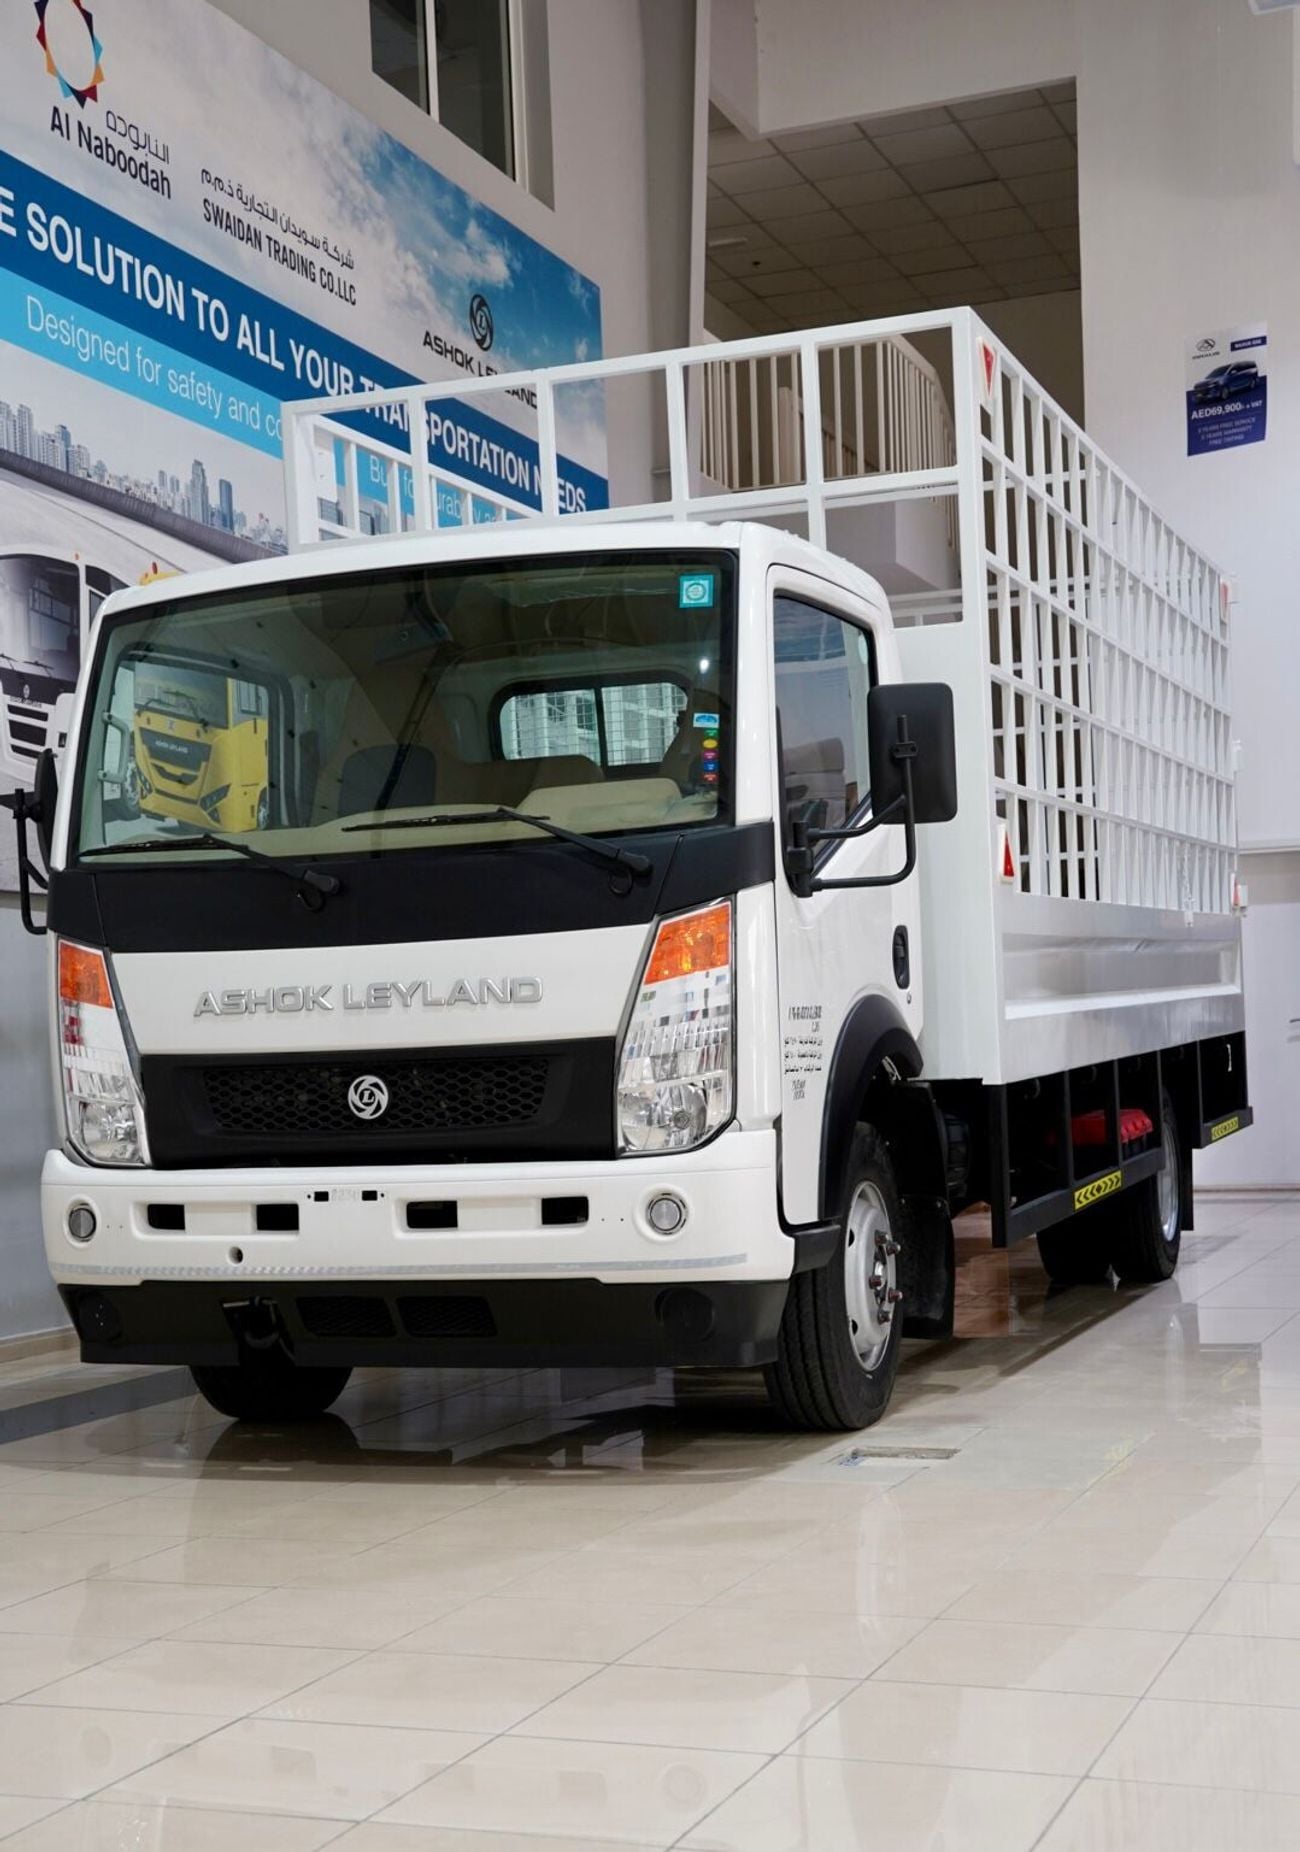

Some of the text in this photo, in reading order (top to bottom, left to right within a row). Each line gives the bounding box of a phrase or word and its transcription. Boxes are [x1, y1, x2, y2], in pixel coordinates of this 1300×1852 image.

[50, 105, 171, 200] Al Naboodah
[236, 183, 279, 225] التجارية
[203, 198, 357, 307] SWAIDAN TRADING CO.LLC
[279, 211, 321, 250] سويدان
[321, 234, 355, 270] شركة
[26, 202, 185, 323] SOLUTION
[191, 289, 230, 342] TO
[236, 313, 286, 373] ALL
[289, 338, 355, 397] YOUR
[27, 295, 130, 372] Designed
[136, 346, 163, 386] for
[167, 368, 223, 420] safety
[228, 395, 261, 431] and
[422, 329, 475, 375] ASHOK
[193, 976, 545, 1018] ASHOK LEYLAND
